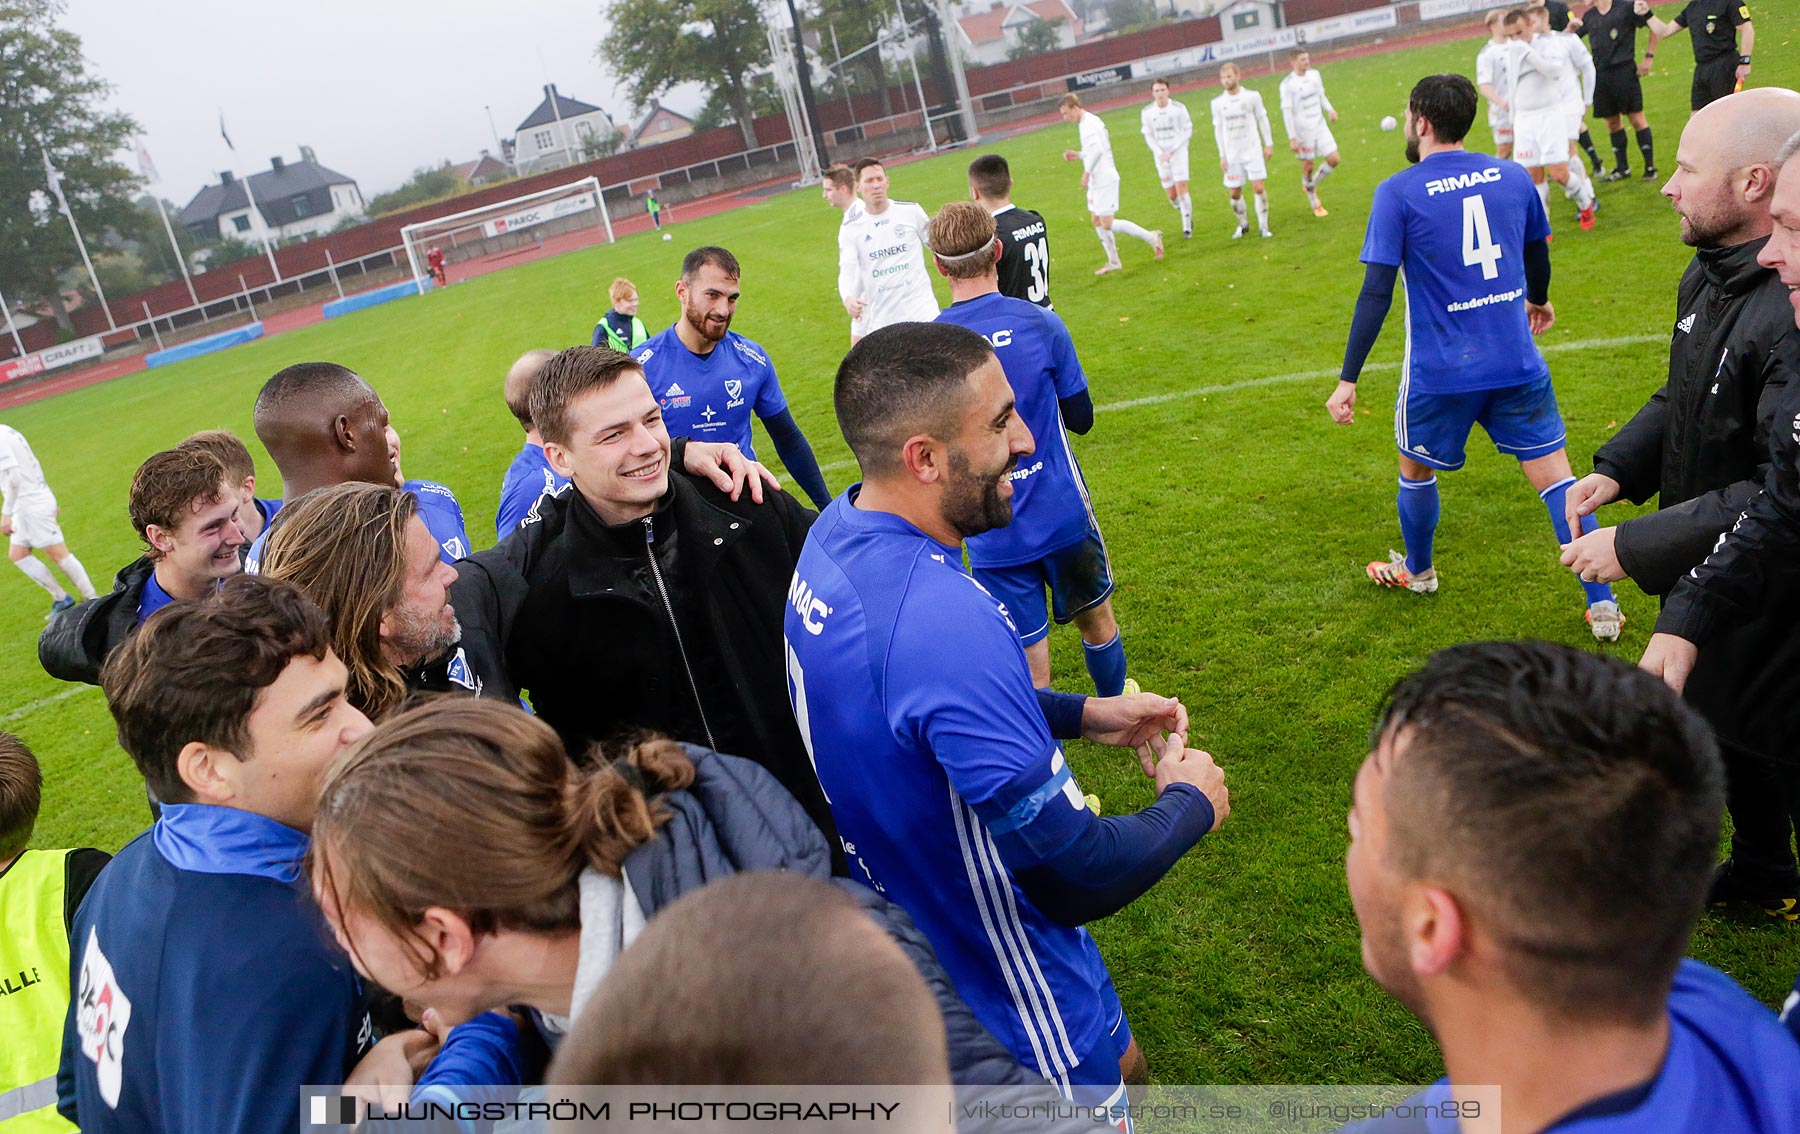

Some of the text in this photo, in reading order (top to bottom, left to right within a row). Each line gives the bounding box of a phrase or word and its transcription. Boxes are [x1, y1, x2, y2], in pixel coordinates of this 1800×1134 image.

[508, 211, 540, 229] PAROC
[1462, 194, 1502, 281] 4
[869, 243, 908, 261] SERNEKE
[872, 262, 910, 278] Derome
[1024, 237, 1048, 302] 31
[45, 344, 86, 363] CRAFT
